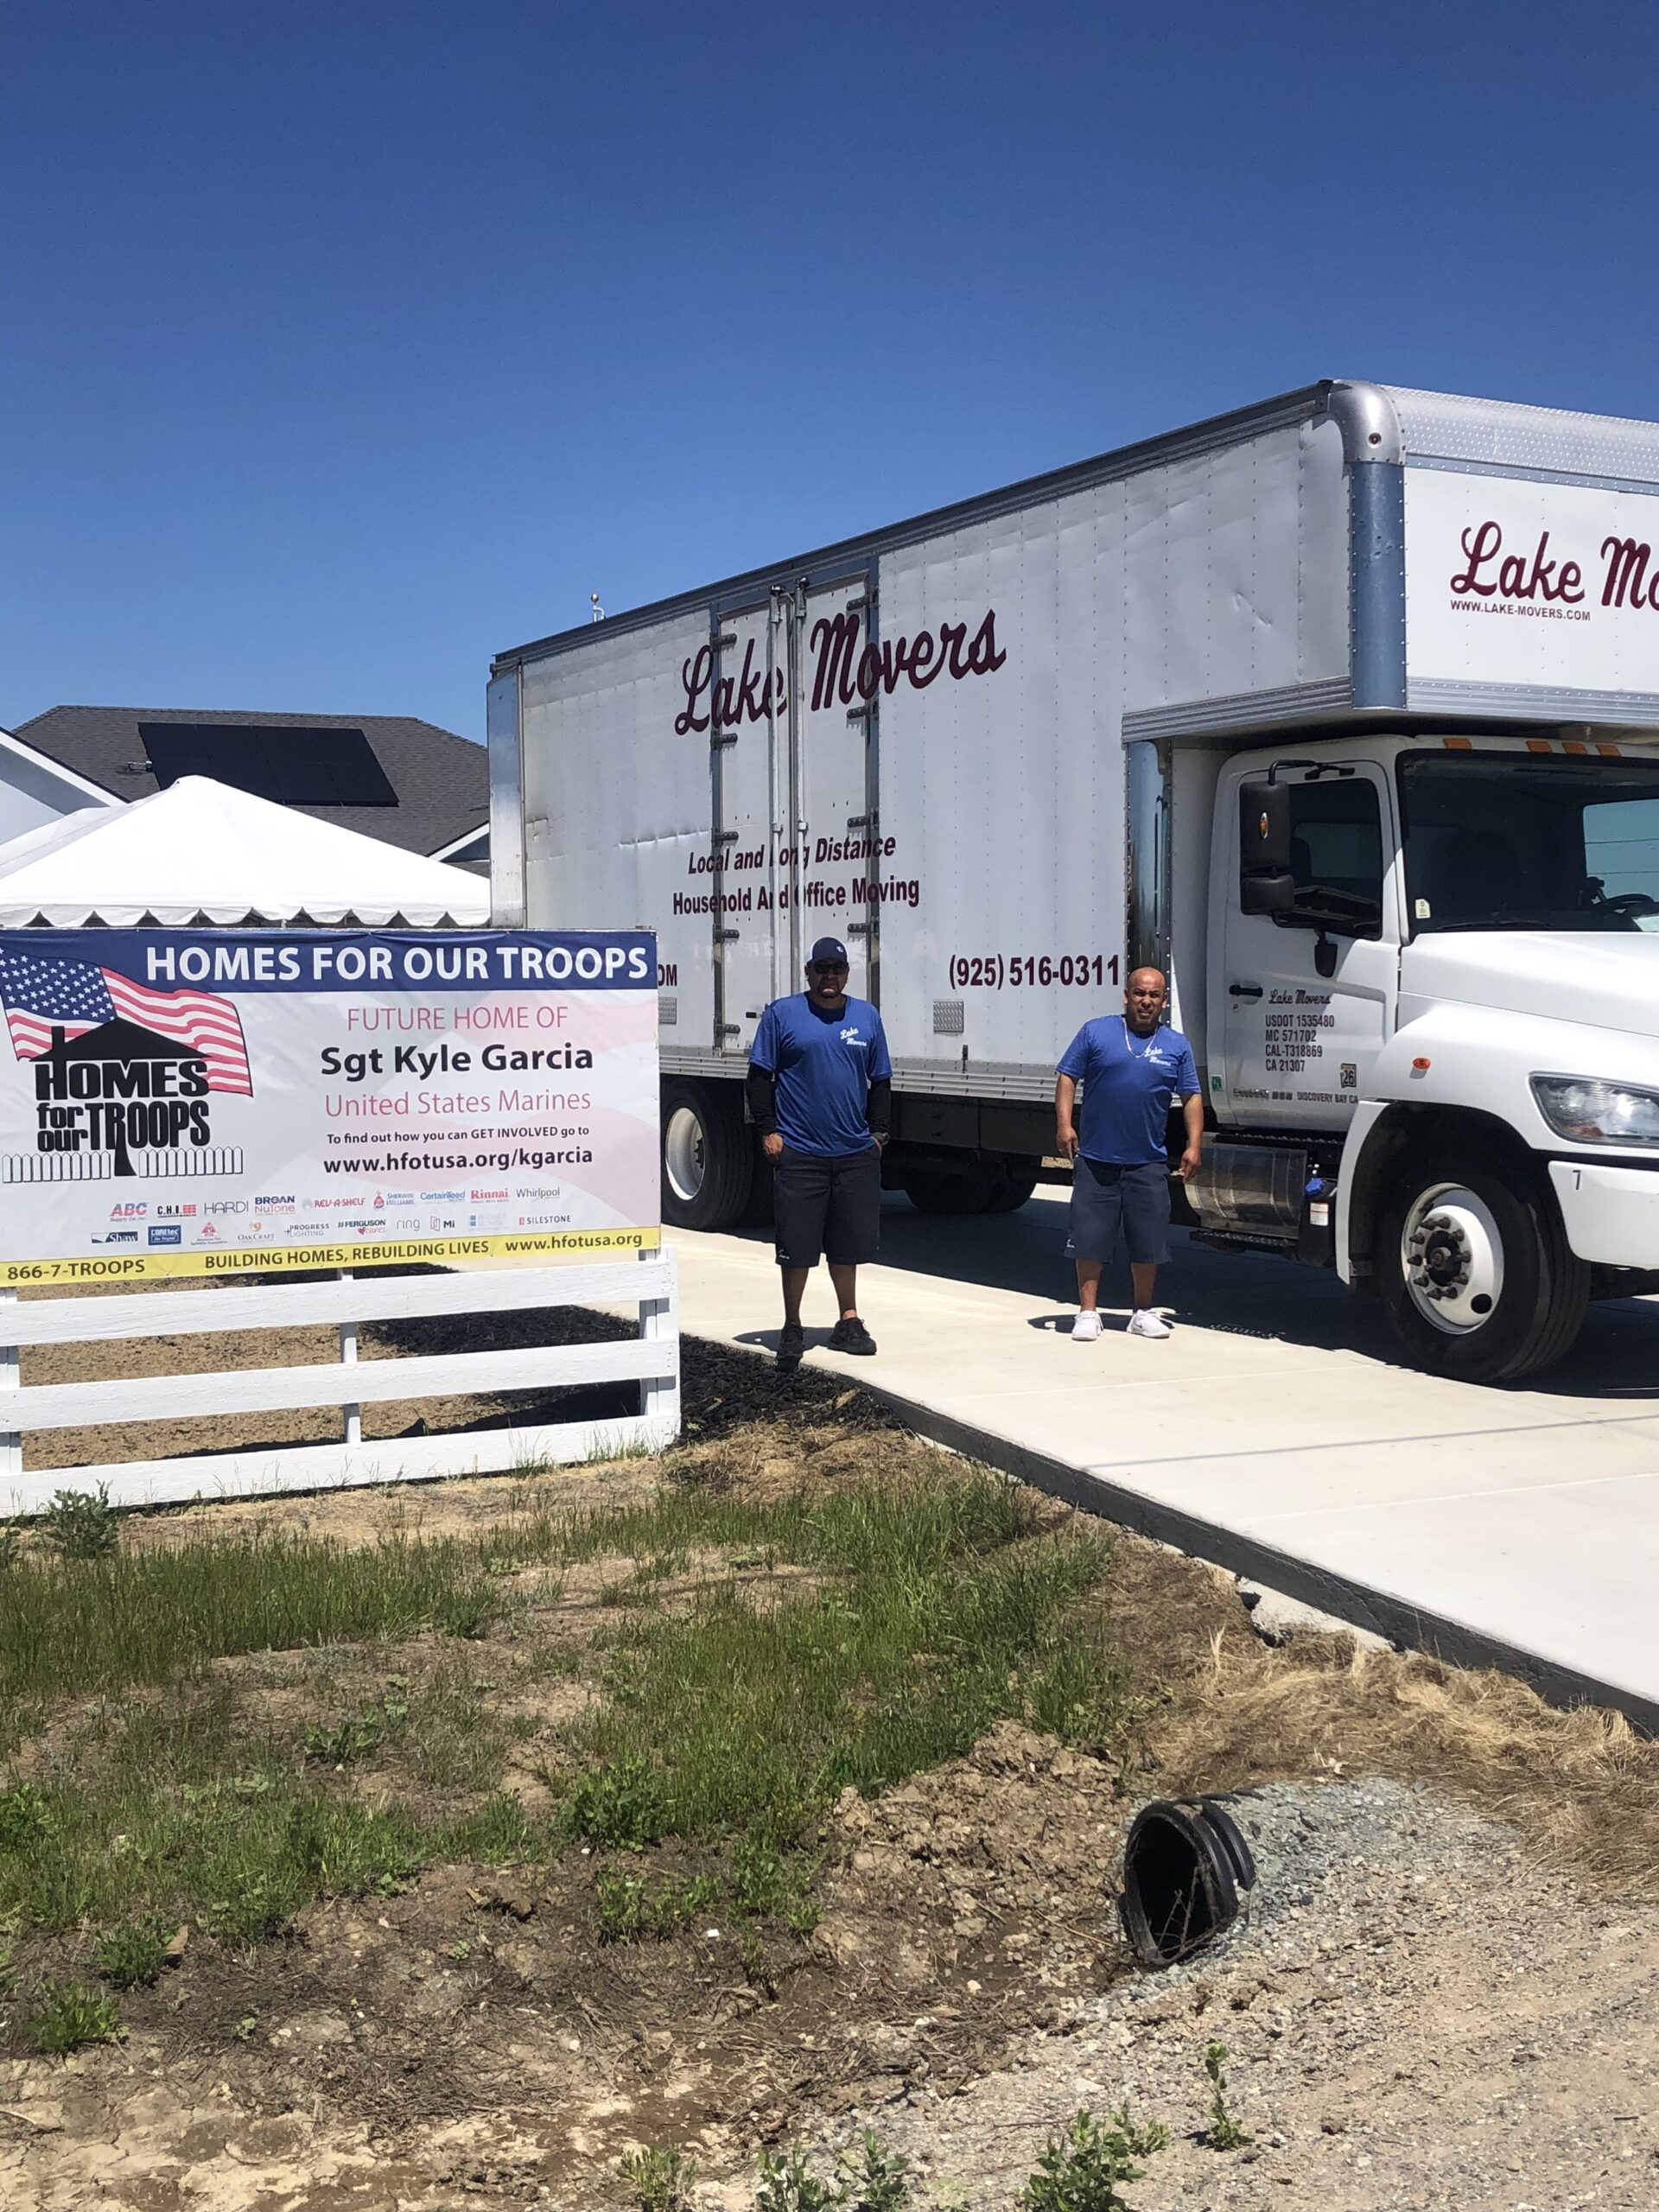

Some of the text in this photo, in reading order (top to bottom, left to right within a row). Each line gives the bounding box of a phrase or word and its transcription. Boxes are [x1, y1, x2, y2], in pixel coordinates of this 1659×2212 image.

[1450, 521, 1585, 603] Lake
[1450, 600, 1591, 620] WWW.LAKE-MOVERS.COM
[675, 609, 1007, 735] Lake Movers
[689, 849, 729, 874] Local
[734, 844, 765, 869] and
[816, 836, 896, 863] Distance
[673, 887, 751, 915] Household
[852, 875, 919, 907] Moving
[147, 947, 648, 981] HOMES FOR OUR TROOPS
[949, 954, 1119, 990] (925) 516-0311
[1268, 989, 1332, 1005] Lake Movers
[347, 1006, 568, 1031] FUTURE HOME OF
[1265, 1014, 1335, 1027] USDOT 1535480
[1265, 1029, 1317, 1042] MC 571702
[1265, 1044, 1323, 1058] CAL-T318869
[321, 1042, 593, 1082] Sgt Kyle Garcia
[1265, 1059, 1306, 1072] CA 21307
[35, 1060, 211, 1100] HOMES
[325, 1089, 592, 1116] United States Marines
[1297, 1091, 1332, 1103] DISCOVERY
[1335, 1093, 1348, 1103] BAY
[1349, 1095, 1359, 1103] CA
[36, 1100, 210, 1150] for TROOPS
[37, 1129, 88, 1152] our
[327, 1126, 589, 1144] To find out how you can GET INVOLVED go to
[324, 1146, 593, 1173] www.hfotusa.org/kgarcia
[1573, 1169, 1581, 1190] 7
[255, 1196, 296, 1205] BROAN
[420, 1191, 465, 1200] CertainTeed
[470, 1188, 509, 1199] Rinnai
[516, 1186, 561, 1199] Whirlpool
[111, 1203, 147, 1217] ABC
[204, 1201, 249, 1214] HARDI
[255, 1204, 296, 1213] NuTone
[397, 1218, 420, 1231] ring
[443, 1220, 455, 1229] Mi
[527, 1215, 571, 1224] SILESTONE
[109, 1233, 137, 1243] Shaw
[205, 1234, 643, 1268] BUILDING HOMES, REBUILDING LIVES www.hfotusa.org
[7, 1259, 145, 1280] 866-7-TROOPS
